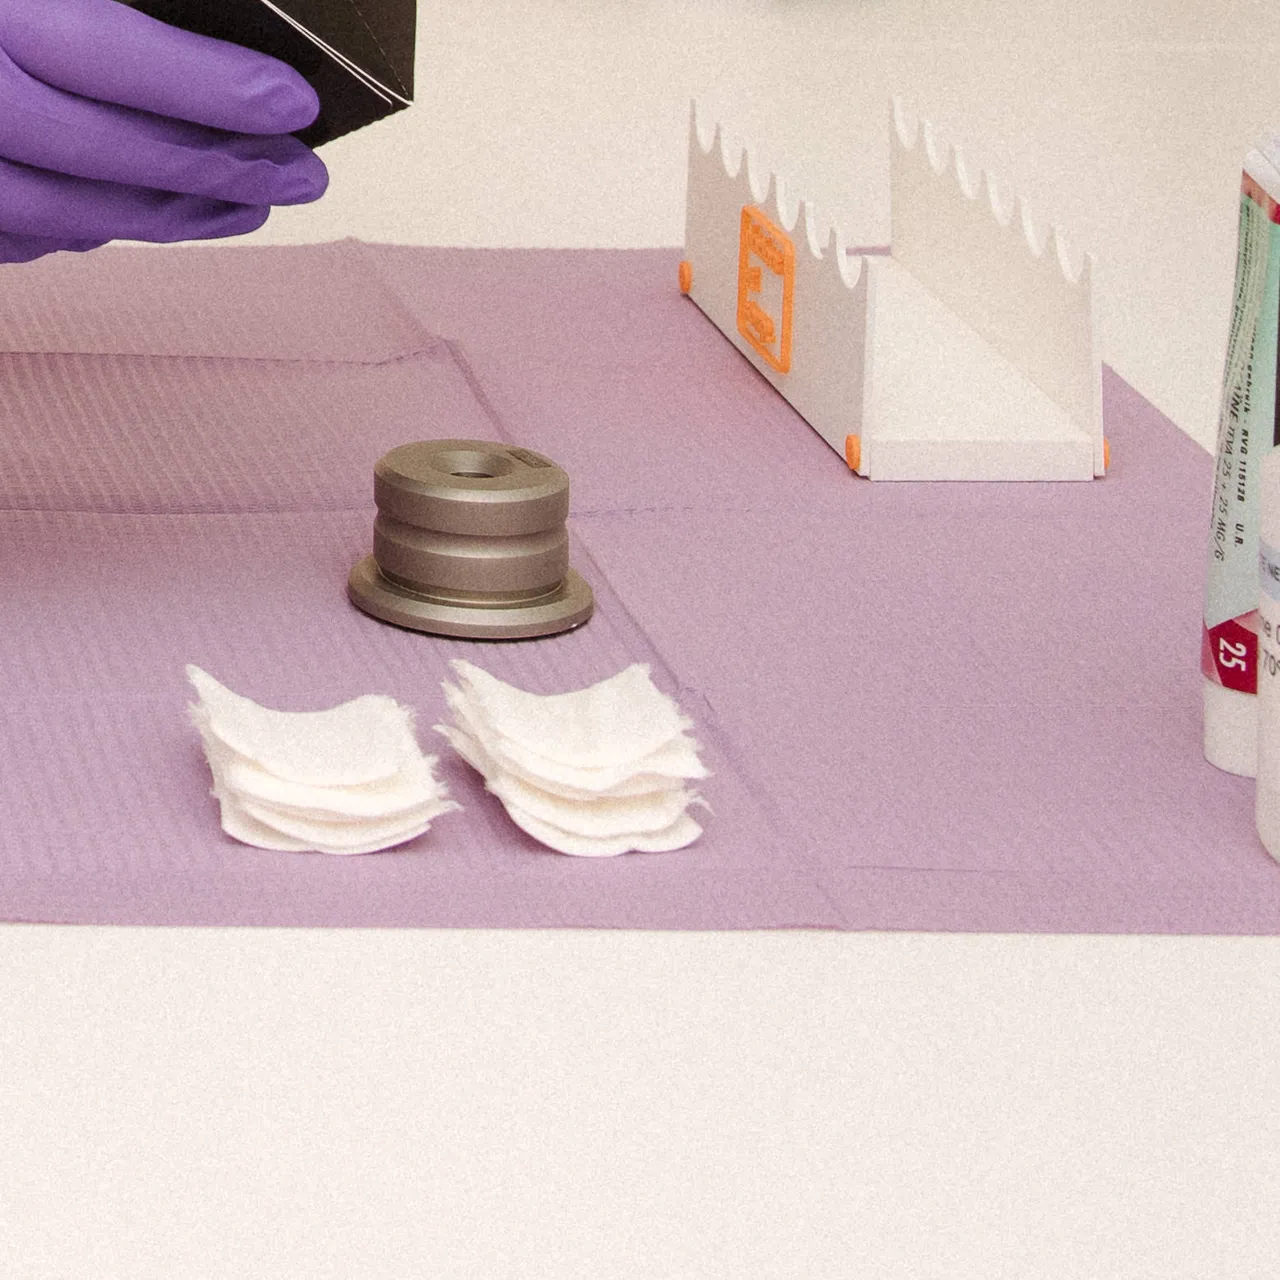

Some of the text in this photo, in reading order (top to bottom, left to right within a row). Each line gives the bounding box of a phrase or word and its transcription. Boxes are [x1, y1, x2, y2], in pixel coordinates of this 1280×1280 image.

[1240, 428, 1249, 455] RVG
[1218, 496, 1228, 517] 25
[1213, 517, 1227, 561] MG/G
[1219, 637, 1247, 672] 25
